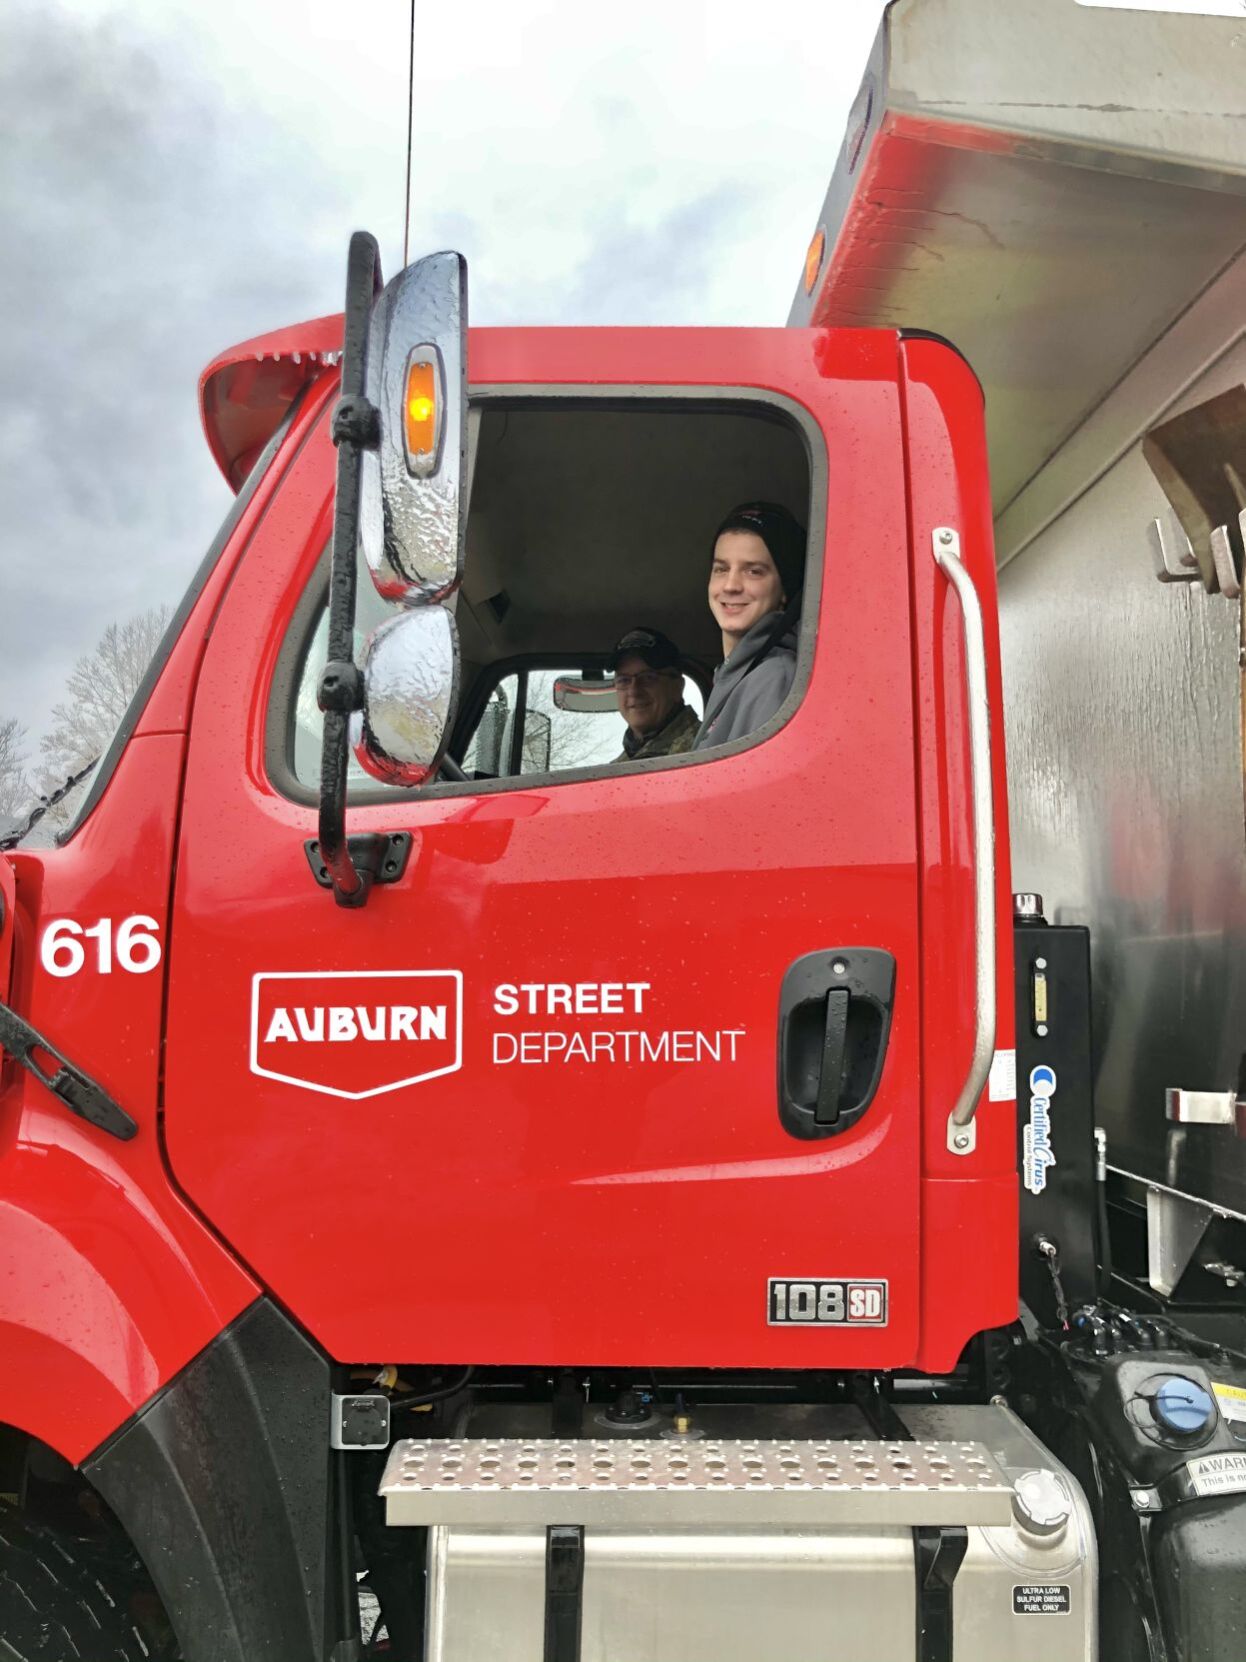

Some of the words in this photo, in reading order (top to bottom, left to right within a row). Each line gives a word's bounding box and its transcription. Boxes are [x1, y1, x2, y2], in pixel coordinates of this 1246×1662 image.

[40, 914, 162, 978] 616
[493, 981, 651, 1016] STREET
[264, 1005, 447, 1043] AUBURN
[492, 1029, 746, 1064] DEPARTMENT
[774, 1283, 845, 1320] 108
[850, 1288, 881, 1317] SD
[1016, 1595, 1043, 1603] SULFUR
[1043, 1595, 1067, 1603] DIESEL
[1022, 1587, 1044, 1595] ULTRA
[1045, 1587, 1061, 1595] LOW
[1023, 1604, 1041, 1612] FUEL
[1042, 1604, 1060, 1612] ONLY
